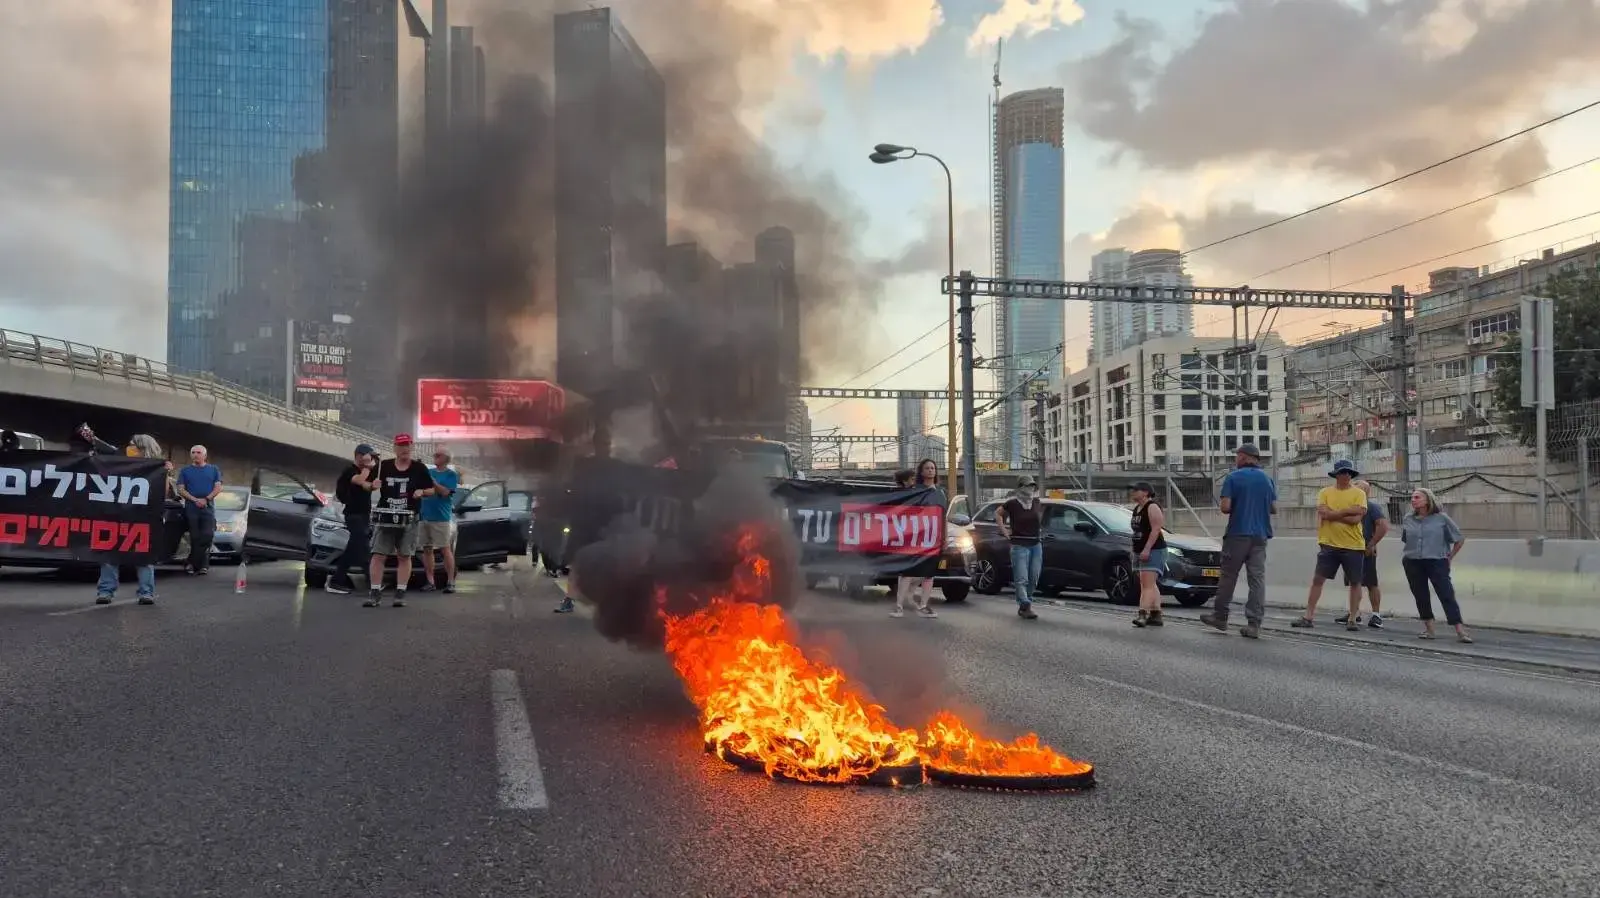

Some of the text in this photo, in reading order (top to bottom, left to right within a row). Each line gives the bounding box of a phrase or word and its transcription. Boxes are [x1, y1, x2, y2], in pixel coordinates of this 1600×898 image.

[432, 394, 479, 412] הבנק
[0, 463, 150, 505] מצילים
[0, 513, 150, 553] מסיימים
[797, 509, 938, 549] עוצרים עד
